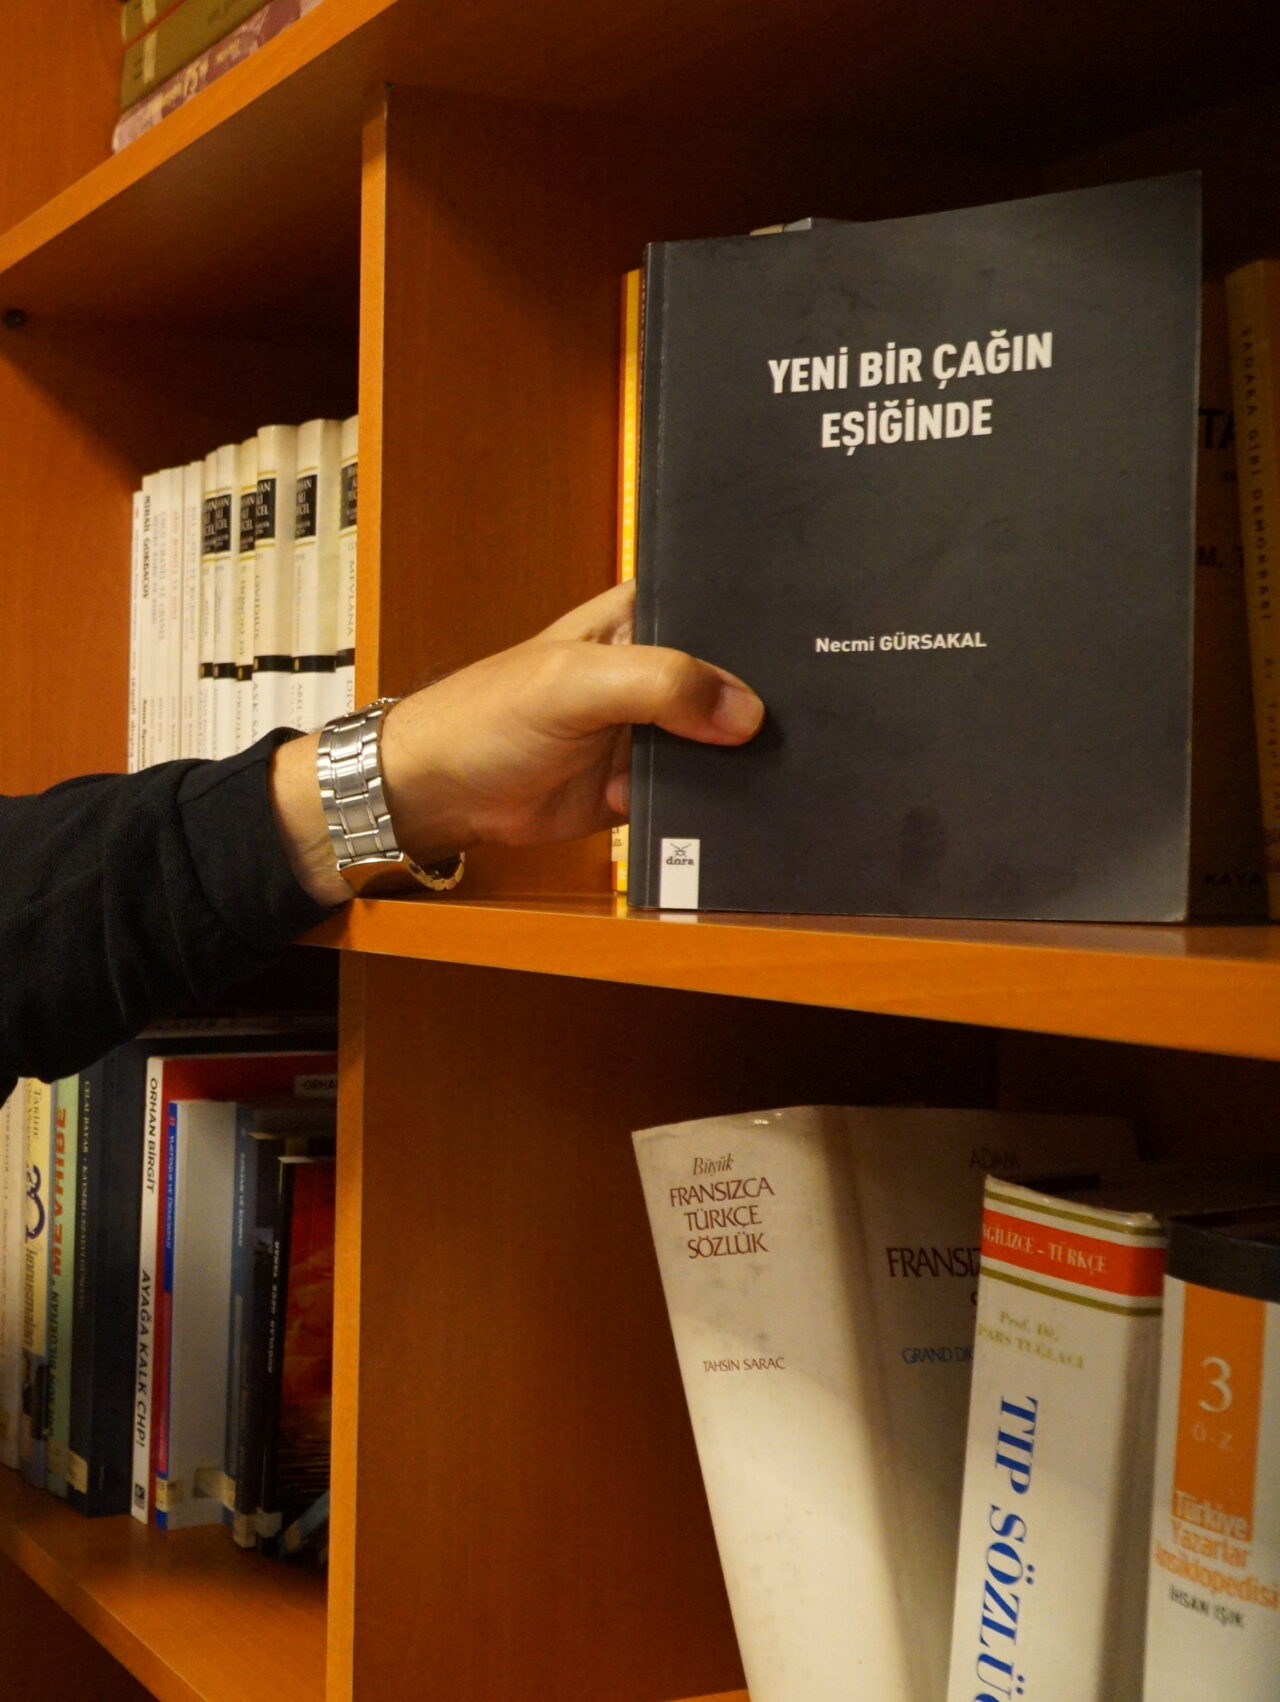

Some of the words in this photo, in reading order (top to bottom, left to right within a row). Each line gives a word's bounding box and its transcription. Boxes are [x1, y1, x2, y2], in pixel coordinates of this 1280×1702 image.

[768, 346, 848, 394] YENİ
[859, 341, 923, 388] BİR
[932, 328, 1053, 390] ÇAĞIN
[821, 397, 993, 456] EŞİĞİNDE
[816, 636, 875, 653] Necmi
[879, 631, 987, 651] GÜRSAKAL
[665, 856, 696, 866] dora
[148, 1077, 159, 1137] ORHAN
[145, 1140, 157, 1195] BİRGİT
[669, 1176, 775, 1208] FRANSIZCA
[692, 1152, 735, 1177] Büyük
[683, 1204, 763, 1232] TÜRKÇE
[686, 1230, 769, 1259] SÖZLÜK
[138, 1268, 153, 1337] AYAĞA
[137, 1341, 148, 1397] KALK
[1198, 1355, 1233, 1413] 3
[135, 1400, 147, 1449] CHP!
[994, 1395, 1039, 1495] TIP
